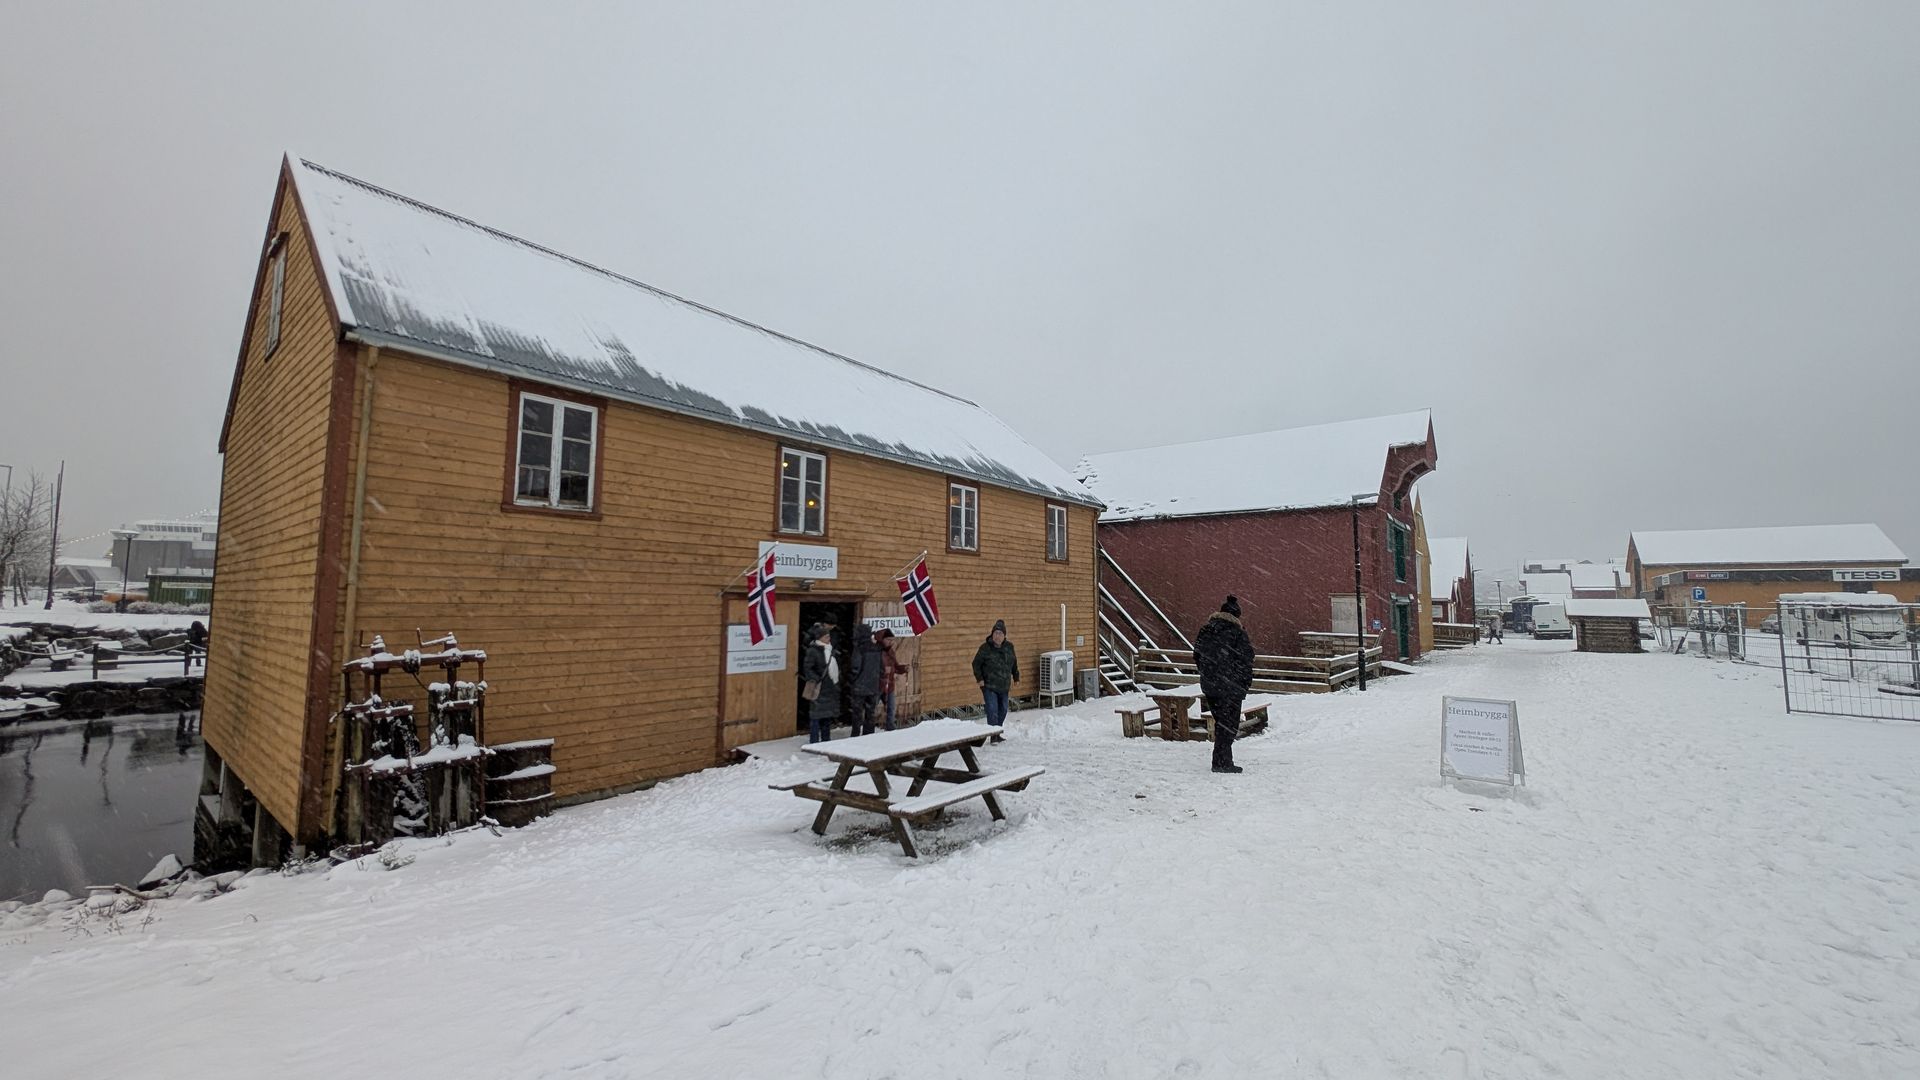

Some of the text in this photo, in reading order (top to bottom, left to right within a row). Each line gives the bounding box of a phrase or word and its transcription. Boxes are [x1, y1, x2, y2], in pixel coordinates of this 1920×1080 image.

[773, 553, 833, 571] eimbrygga
[1836, 570, 1897, 580] TESS
[1695, 589, 1703, 599] P
[868, 618, 912, 629] UTSTILLIN
[1448, 706, 1508, 720] Heimbrygga
